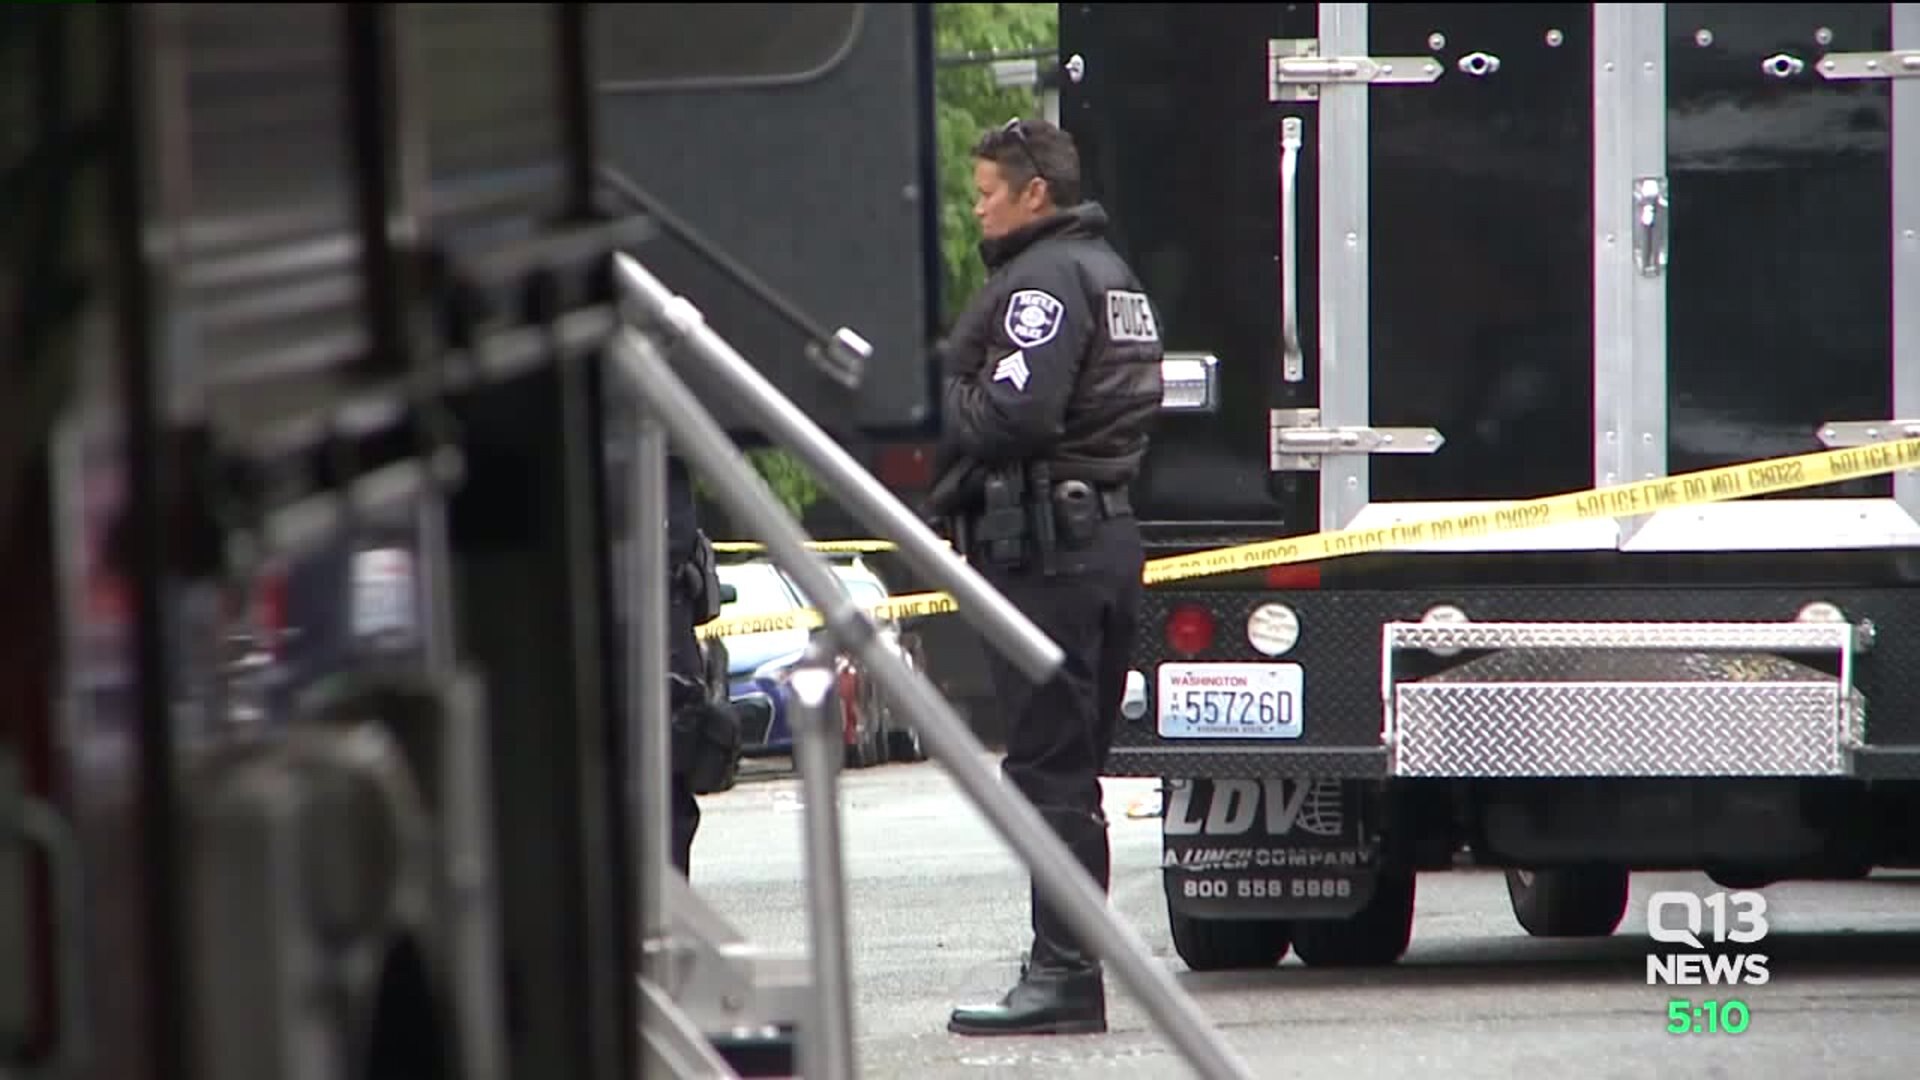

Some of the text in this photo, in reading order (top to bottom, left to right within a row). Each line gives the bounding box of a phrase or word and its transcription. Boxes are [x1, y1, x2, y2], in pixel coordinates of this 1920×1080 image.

[1111, 296, 1153, 336] POLICE
[1170, 676, 1248, 687] WASHINGTON
[1185, 690, 1293, 725] 55726D
[1164, 779, 1312, 835] LDV
[1165, 849, 1179, 865] A
[1255, 849, 1369, 866] COMPANY
[1184, 879, 1228, 897] 800
